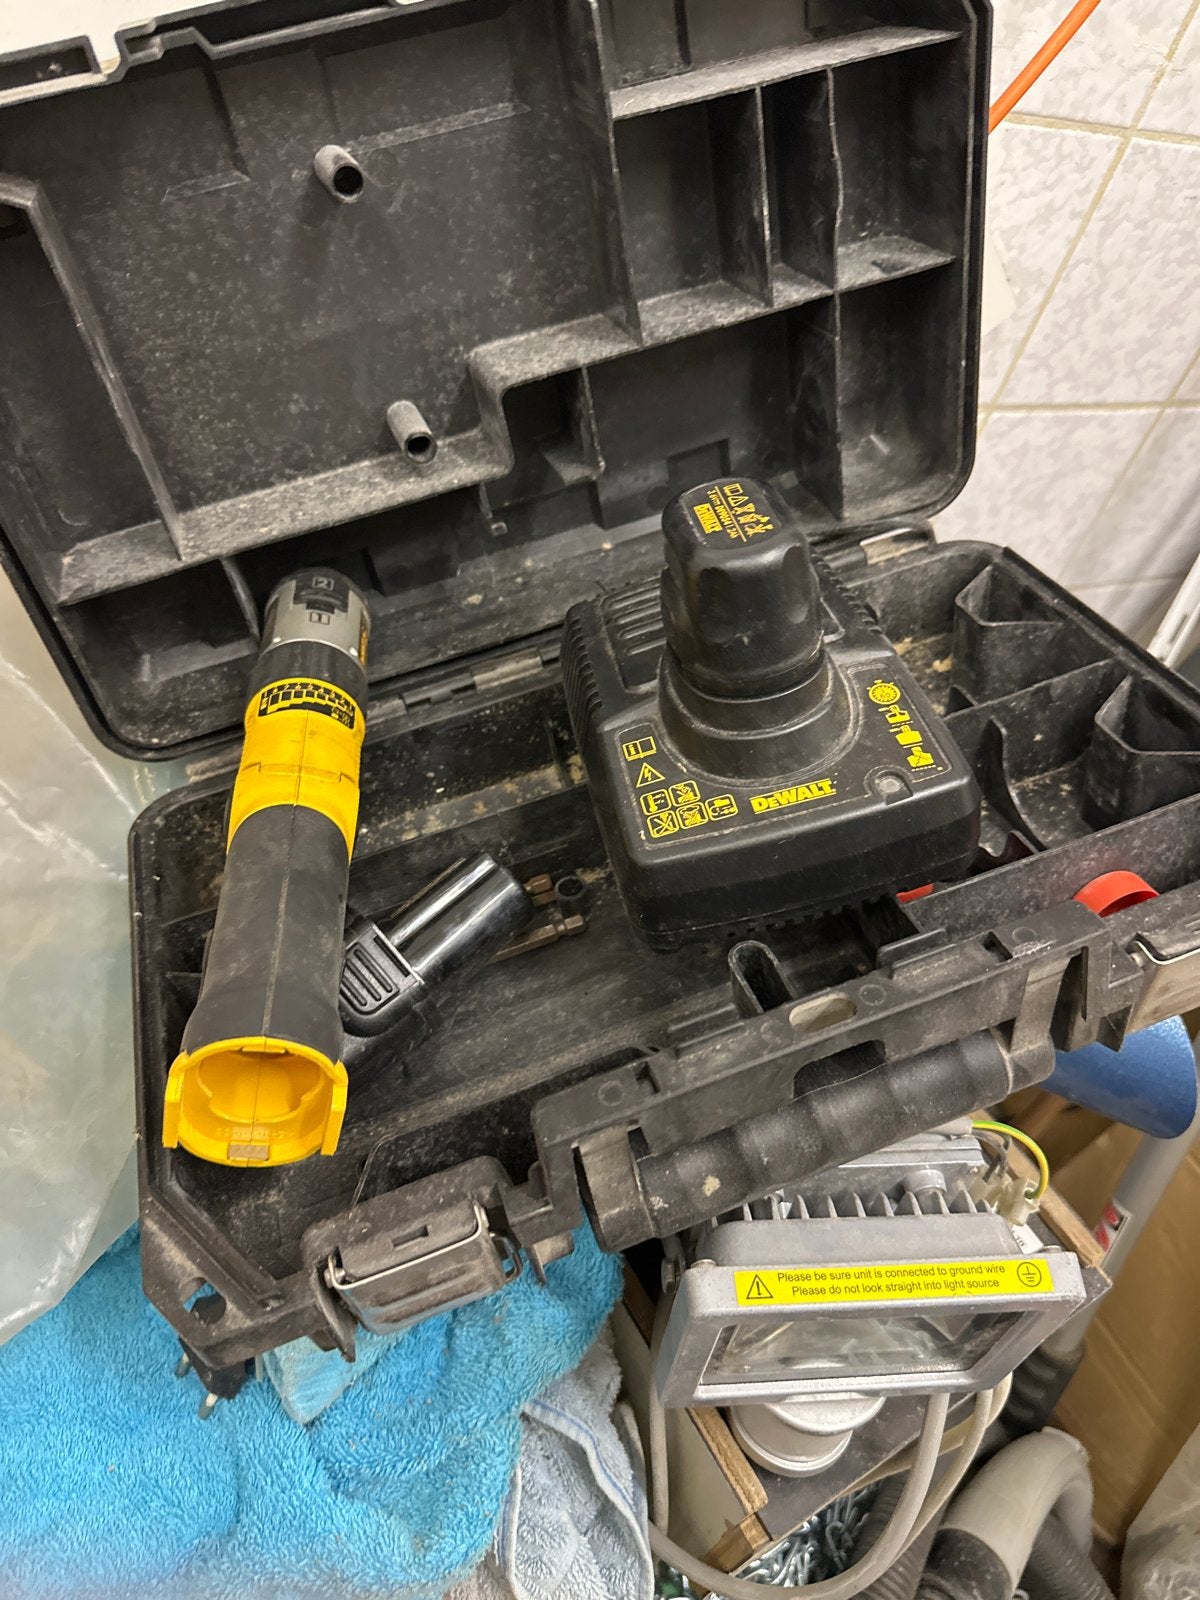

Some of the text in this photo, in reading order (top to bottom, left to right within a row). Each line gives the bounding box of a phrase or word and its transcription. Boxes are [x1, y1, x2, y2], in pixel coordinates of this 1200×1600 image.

[777, 1263, 1006, 1282] Please be sure unit is connected to ground wire
[792, 1278, 1000, 1296] Please do not look straight into light source
